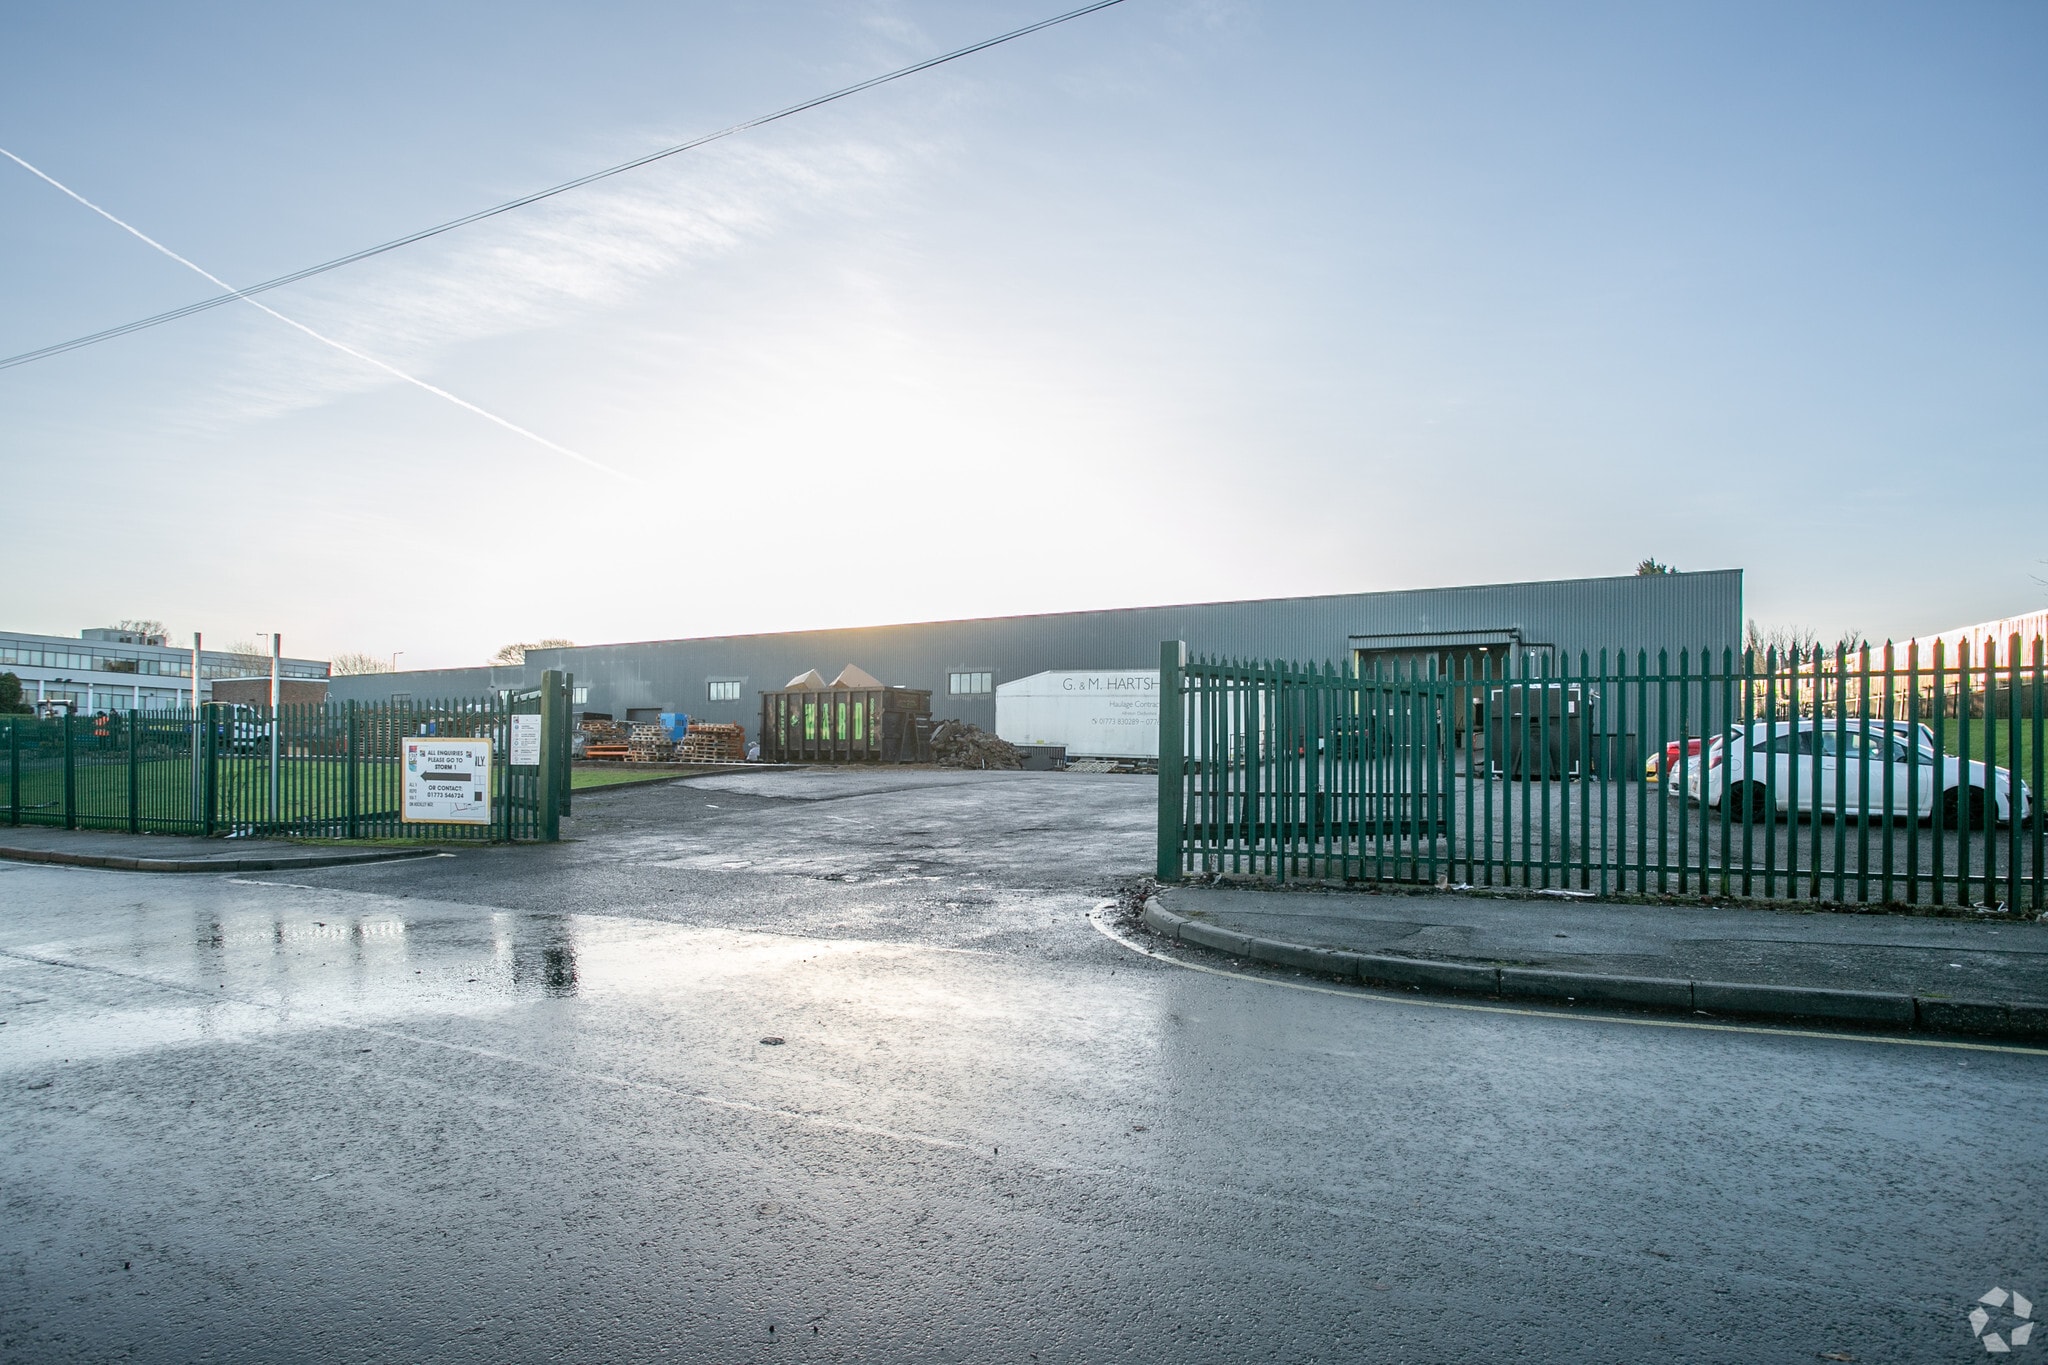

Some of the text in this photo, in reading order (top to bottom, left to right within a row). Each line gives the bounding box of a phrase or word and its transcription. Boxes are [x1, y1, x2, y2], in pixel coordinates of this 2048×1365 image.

[1063, 678, 1076, 690] G.
[1079, 682, 1085, 690] &
[1088, 678, 1103, 690] M.
[1109, 701, 1134, 709] Haulage
[804, 702, 863, 740] WARD
